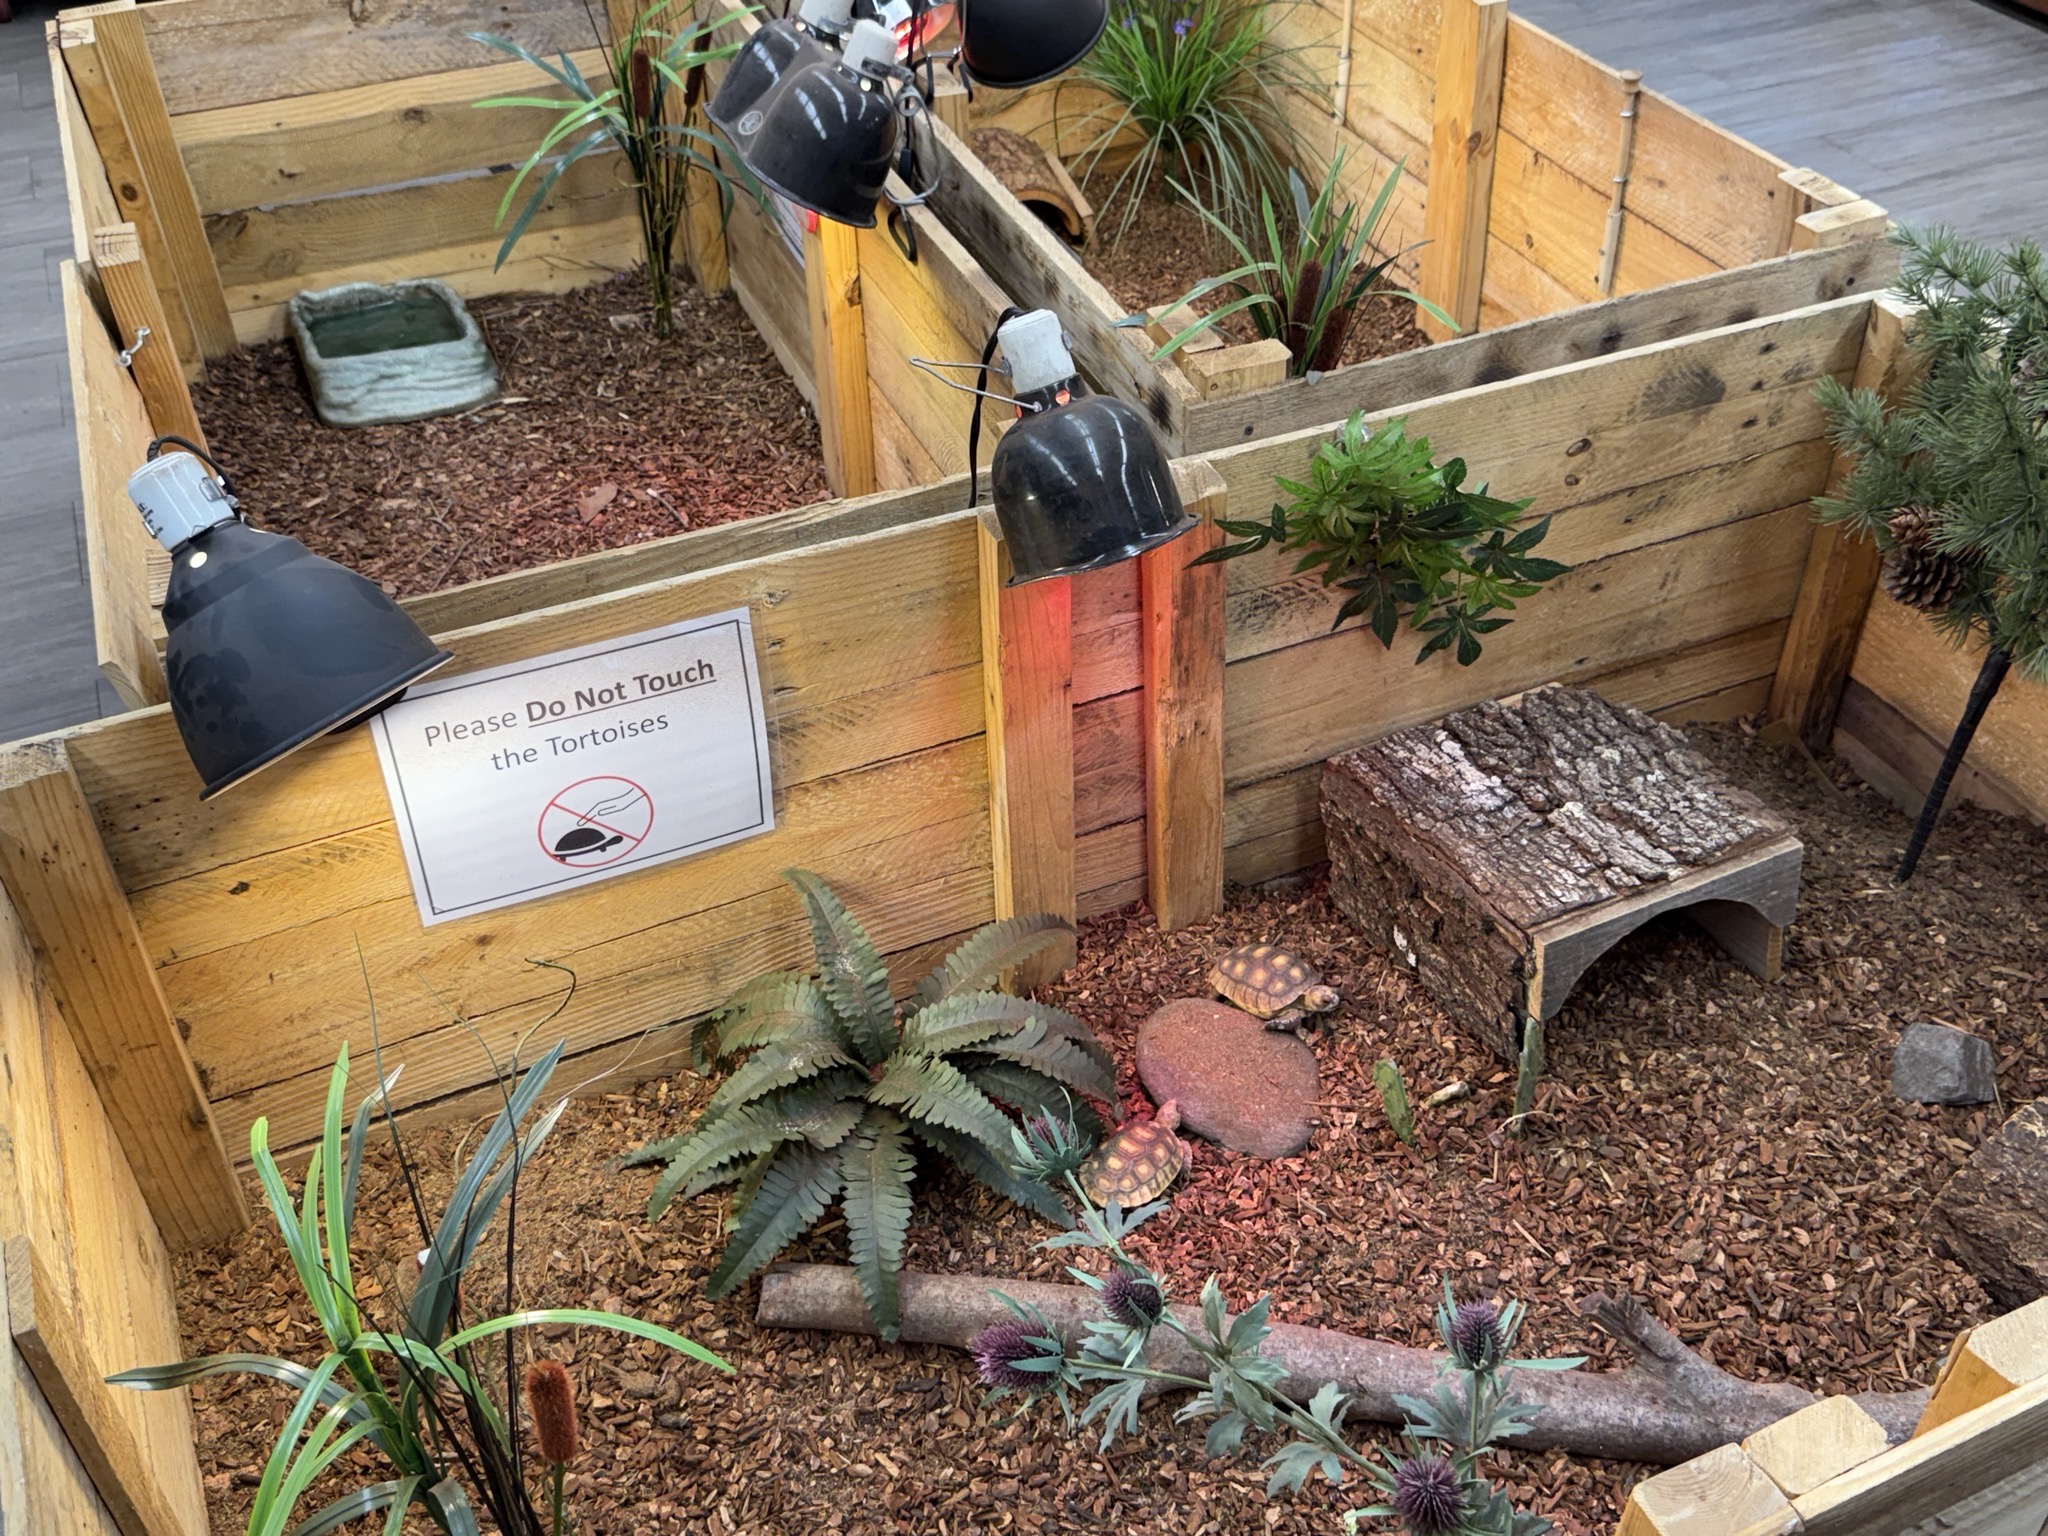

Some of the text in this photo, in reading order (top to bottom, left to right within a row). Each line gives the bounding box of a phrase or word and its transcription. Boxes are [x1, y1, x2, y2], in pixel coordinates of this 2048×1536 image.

[424, 658, 715, 747] Please Do Not Touch
[490, 713, 669, 771] the Tortoises
